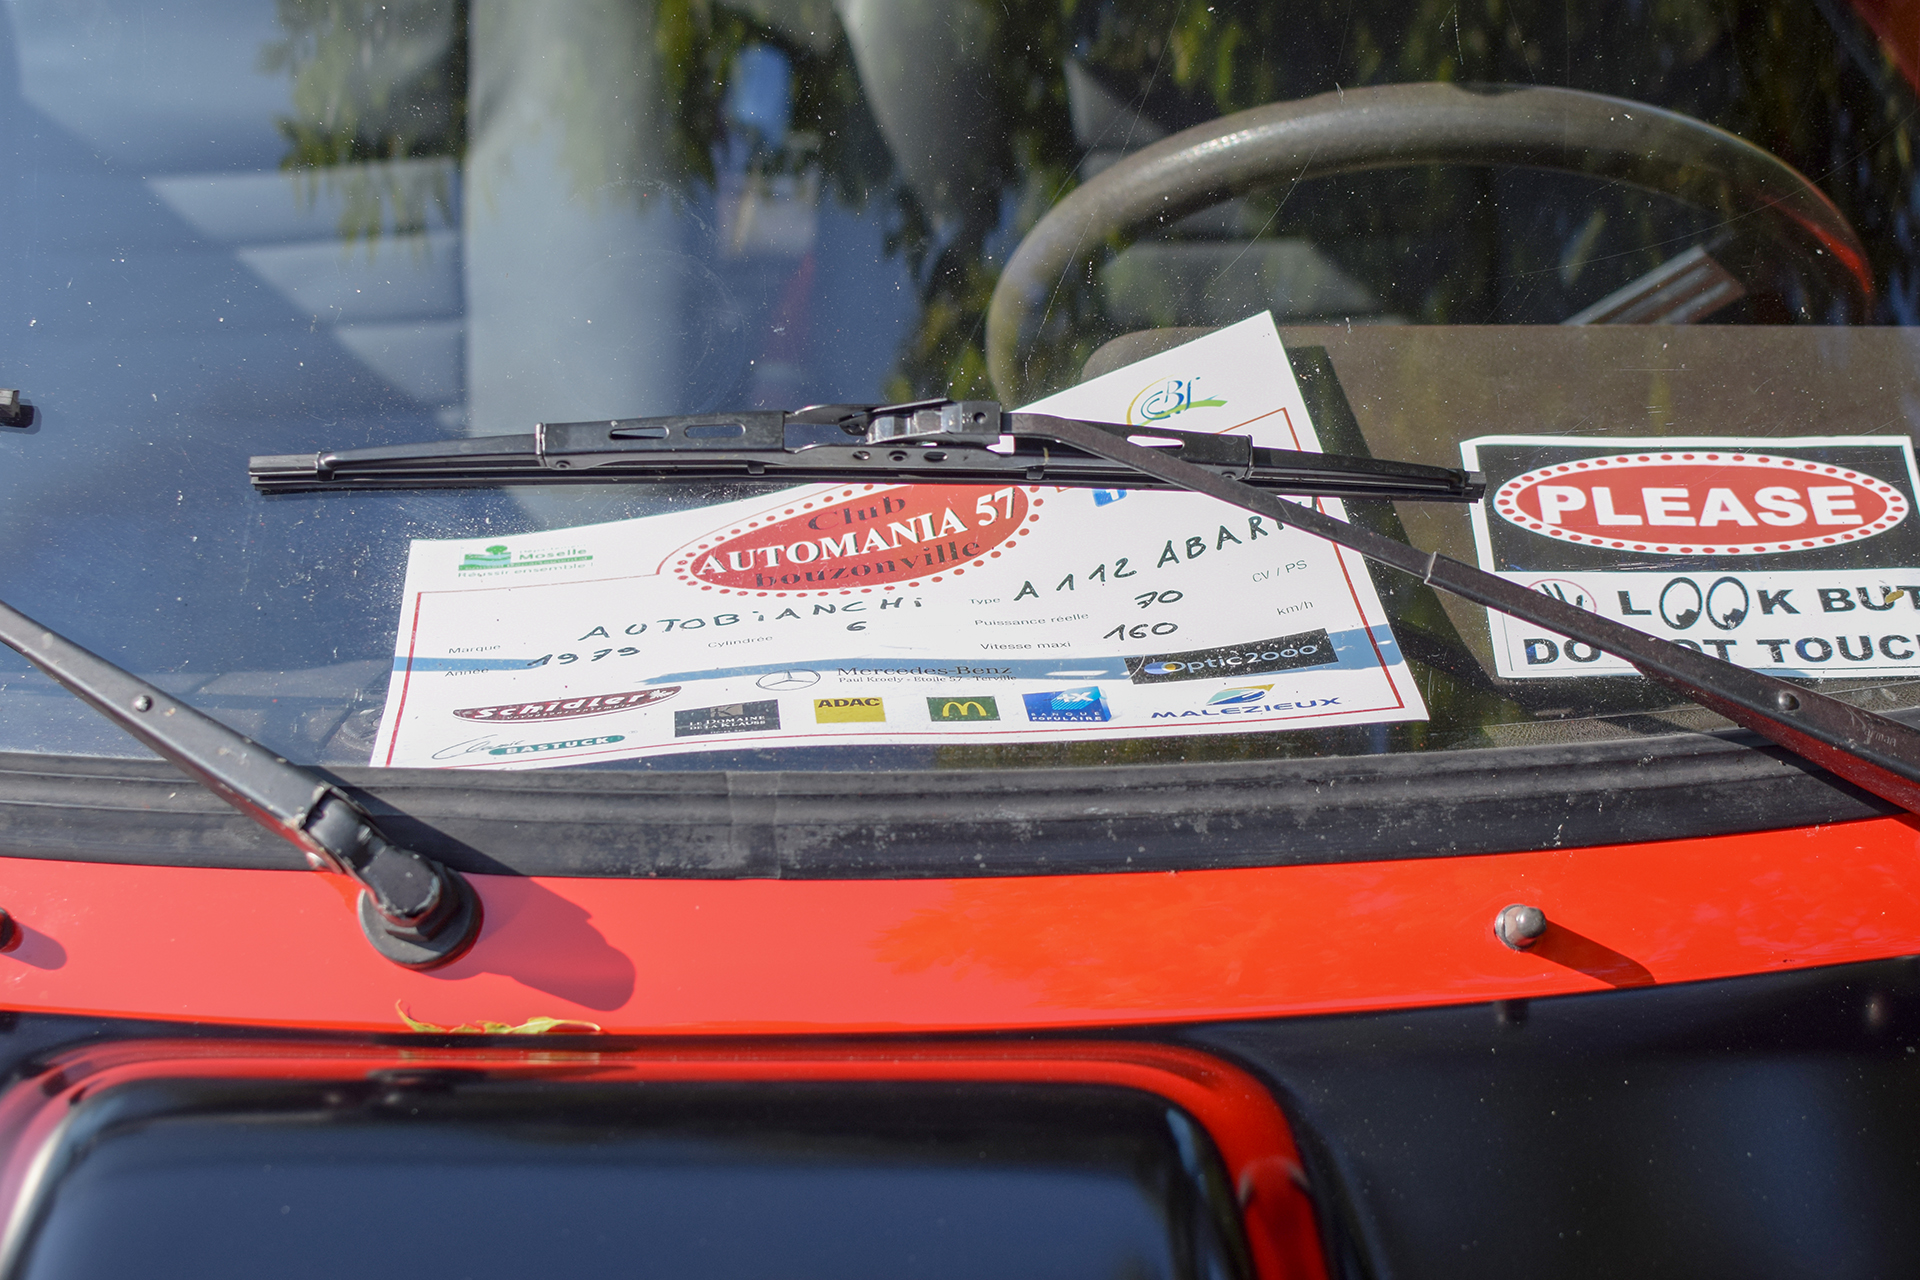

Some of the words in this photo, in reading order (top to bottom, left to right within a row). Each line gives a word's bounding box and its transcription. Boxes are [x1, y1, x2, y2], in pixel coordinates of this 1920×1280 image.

[808, 496, 906, 531] Club
[1537, 485, 1864, 527] PLEASE
[700, 507, 969, 577] AUTOMANIA
[976, 486, 1016, 527] 57
[519, 549, 587, 560] Moselle
[755, 541, 981, 588] bouzonville
[1252, 569, 1270, 584] CV
[1285, 560, 1308, 575] PS
[1013, 580, 1040, 602] A
[970, 597, 1001, 606] Type
[1276, 599, 1315, 617] km/h
[1617, 577, 1801, 630] LOOK
[846, 621, 867, 632] 6
[974, 617, 1047, 627] Puissance
[1050, 613, 1090, 623] réelle
[1103, 621, 1180, 642] 160
[448, 644, 501, 655] Marque
[707, 635, 774, 649] Cylindrée
[980, 642, 1032, 651] Vitesse
[1037, 641, 1071, 649] maxi
[1523, 638, 1602, 665] DO
[1756, 634, 1920, 665] TOUC
[444, 668, 489, 677] Année
[836, 665, 1013, 676] Mercedes-Benz
[818, 697, 881, 709] ADAC
[1150, 697, 1343, 719] MALEZIEUX
[505, 736, 610, 755] BASTUCK
